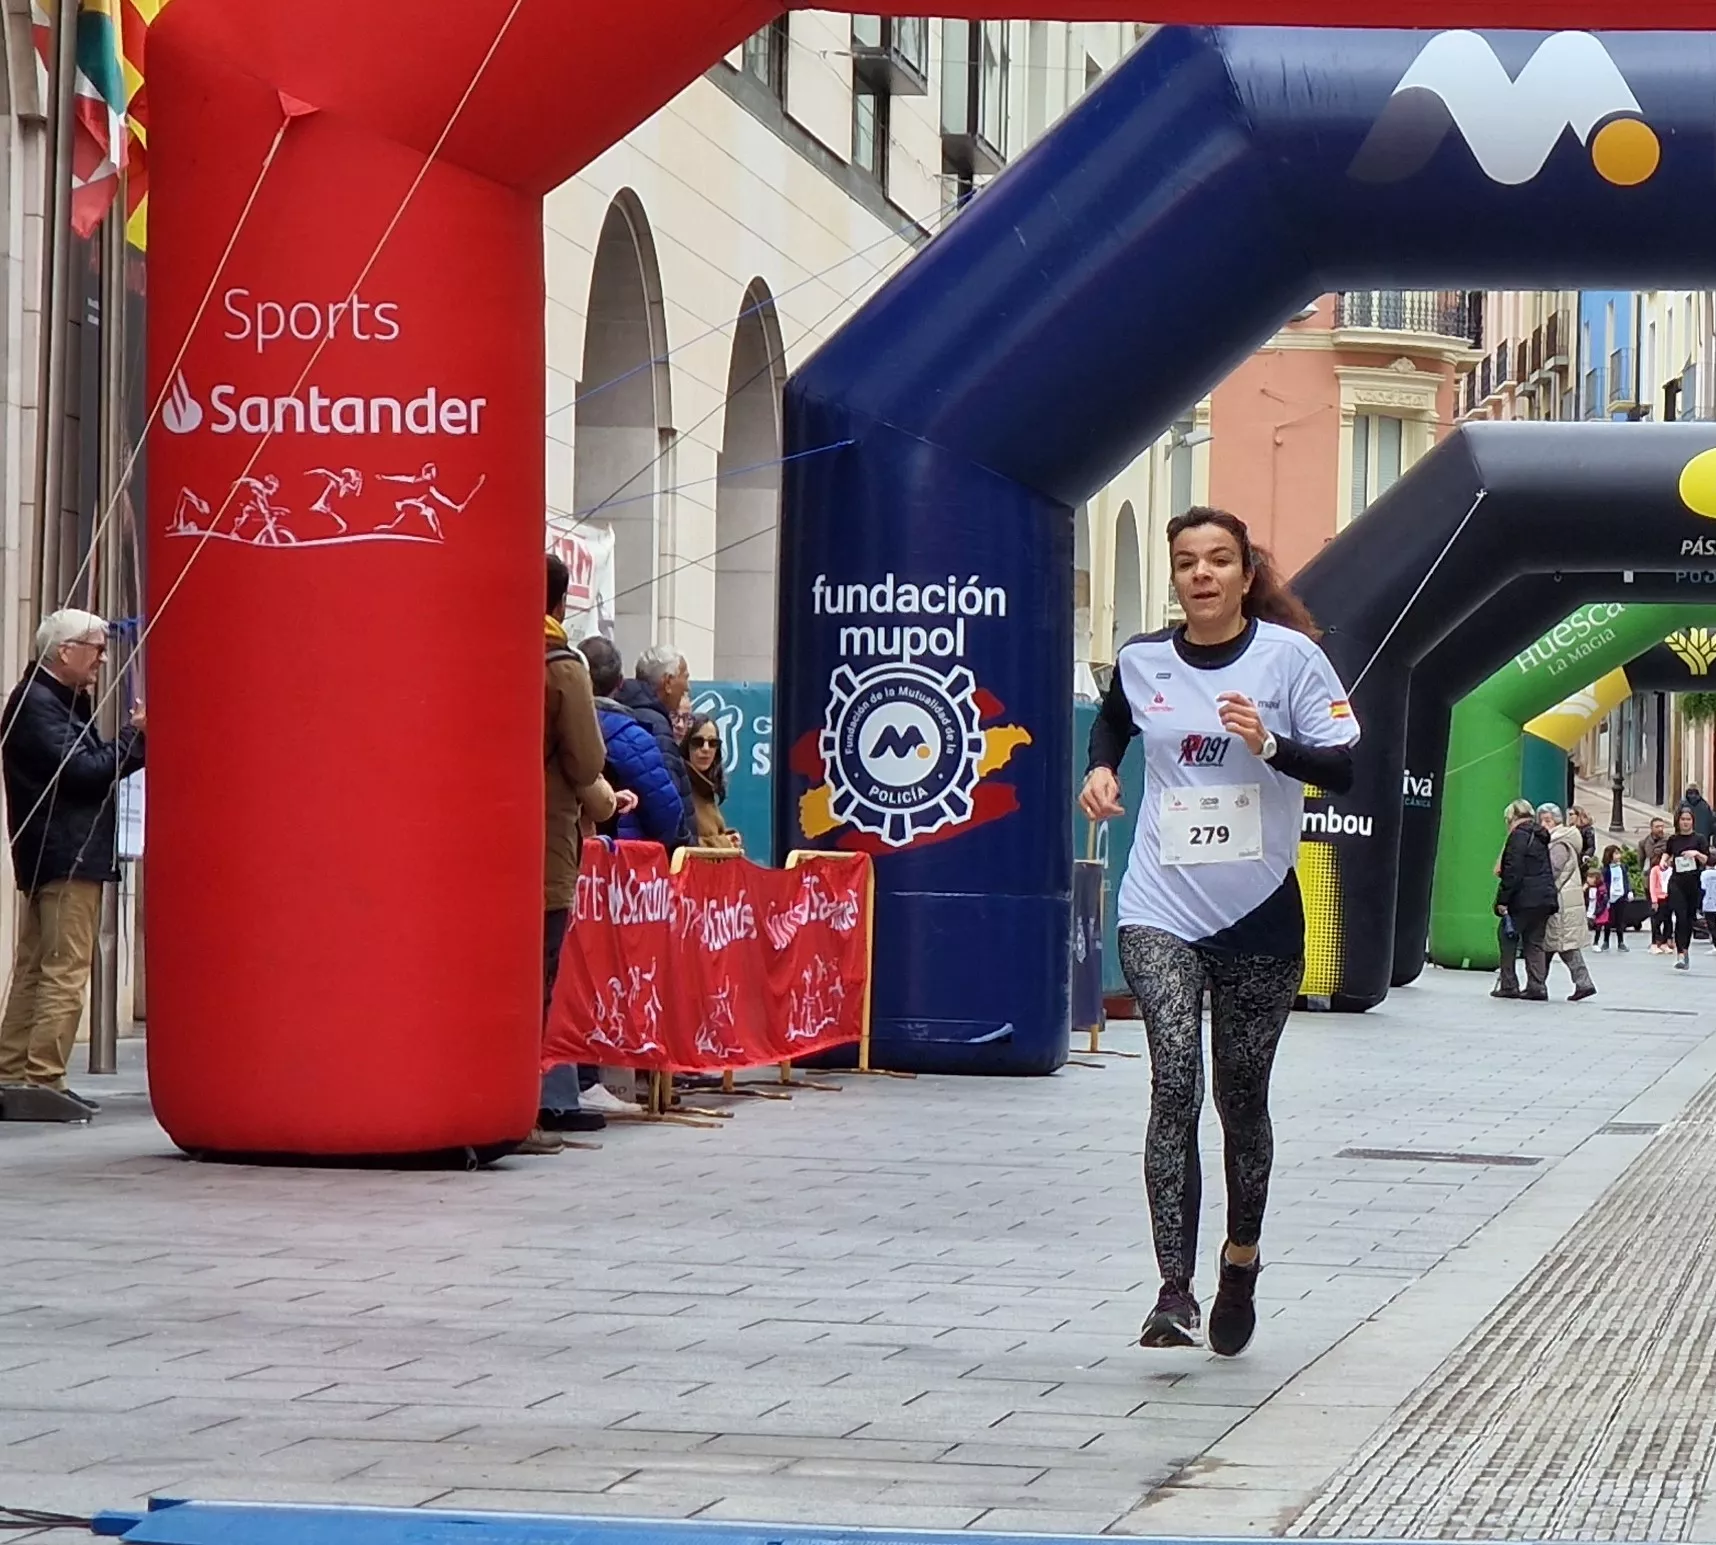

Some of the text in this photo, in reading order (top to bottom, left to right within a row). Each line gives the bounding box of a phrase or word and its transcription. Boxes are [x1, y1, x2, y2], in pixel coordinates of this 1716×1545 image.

[223, 289, 400, 353] Sports
[210, 385, 487, 437] Santander
[812, 573, 1007, 617] fundación
[840, 618, 964, 664] mupol
[844, 701, 871, 755] Fundación
[870, 690, 884, 706] de
[898, 685, 951, 727] Mutualidad
[868, 784, 930, 805] POLICÍA
[1189, 825, 1230, 845] 279
[1302, 805, 1373, 836] mbou
